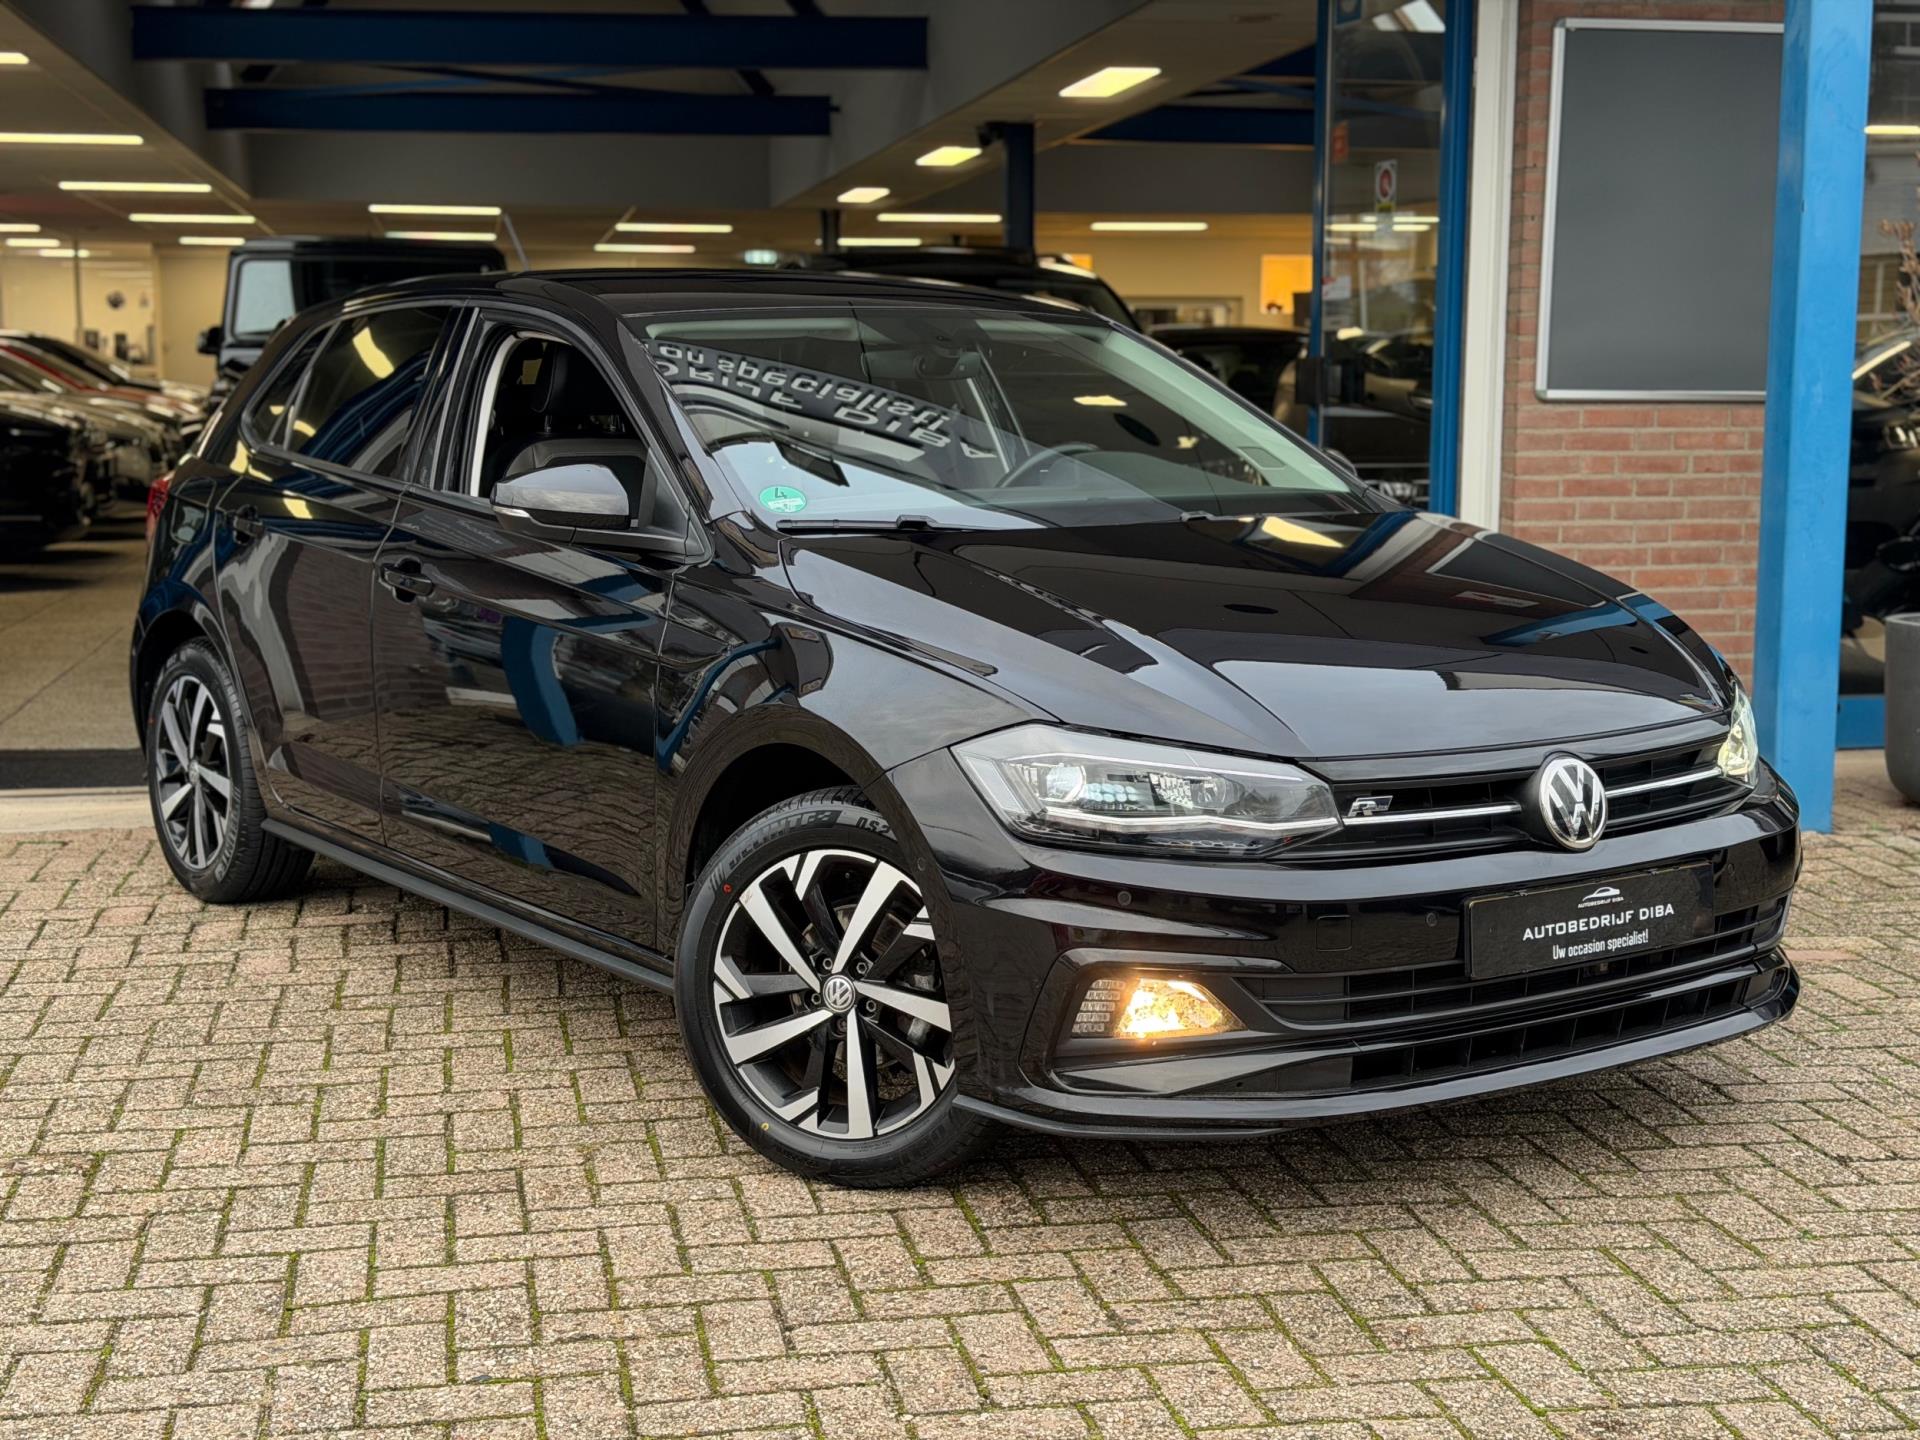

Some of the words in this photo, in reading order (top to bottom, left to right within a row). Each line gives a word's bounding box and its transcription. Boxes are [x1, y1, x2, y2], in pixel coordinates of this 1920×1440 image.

[1522, 910, 1635, 941] AUTOBEDRIJF
[1639, 903, 1675, 921] DIBA
[1552, 944, 1566, 960] Uw
[1568, 938, 1606, 958] occasion
[1607, 928, 1649, 950] specialist!
